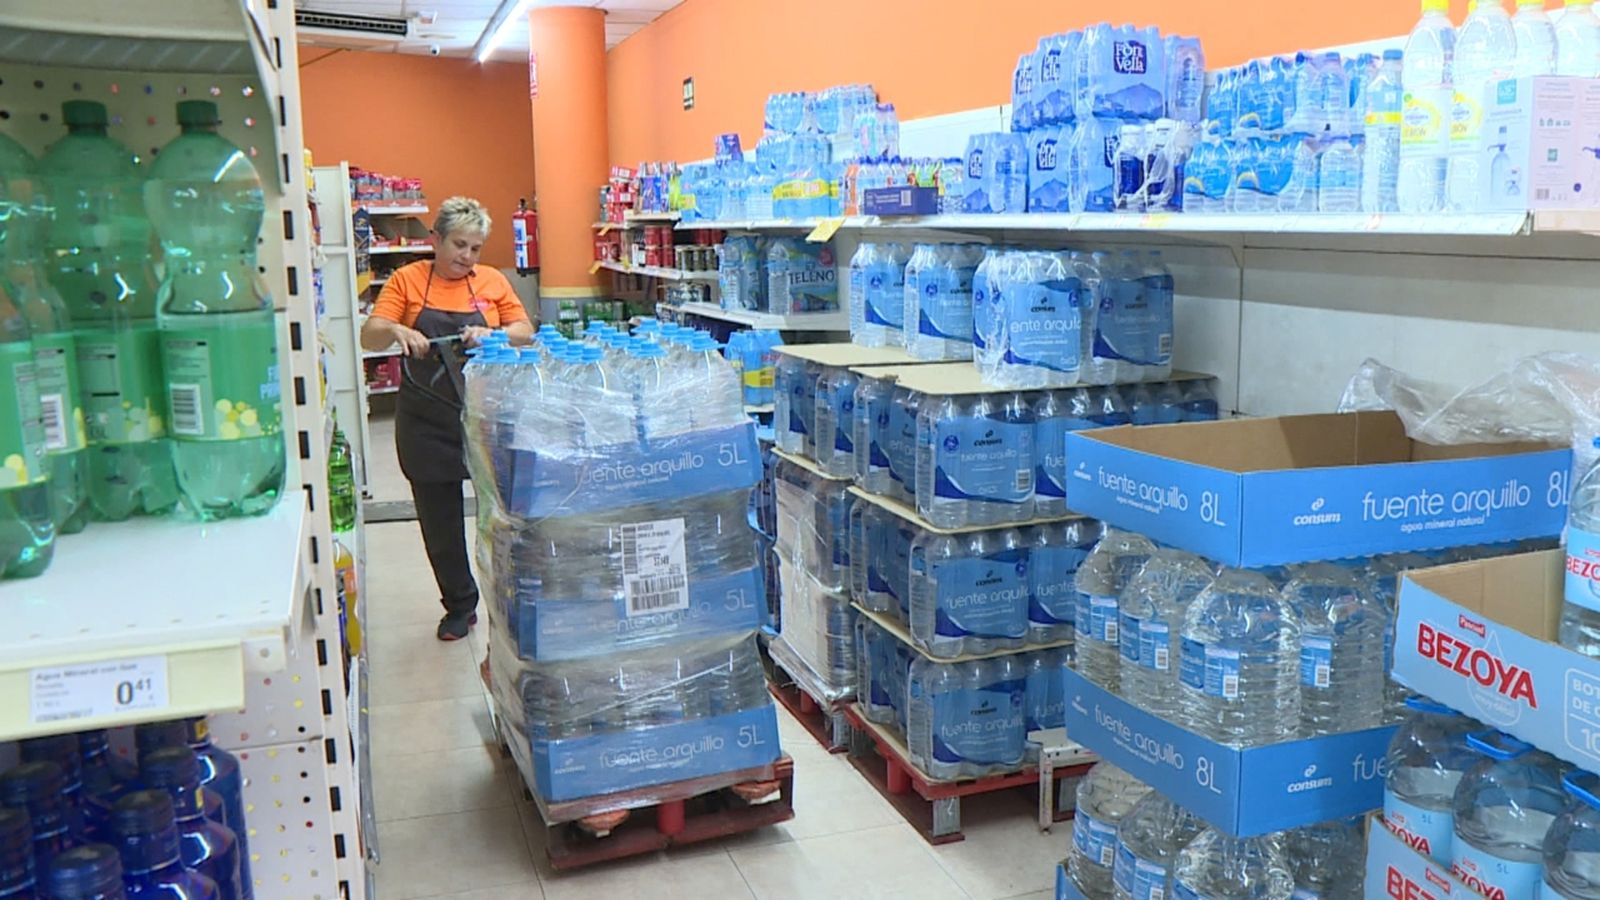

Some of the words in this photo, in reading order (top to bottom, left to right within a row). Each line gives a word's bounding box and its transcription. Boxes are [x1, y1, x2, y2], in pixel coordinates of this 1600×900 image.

[1115, 57, 1144, 73] Vella
[640, 451, 704, 477] arquillo
[718, 443, 747, 467] 5L
[1098, 465, 1136, 496] fuente
[1139, 482, 1188, 511] arquillo
[1200, 490, 1226, 527] 8L
[1362, 489, 1443, 522] fuente
[1451, 479, 1531, 516] arquillo
[1547, 470, 1570, 508] 8L
[1293, 512, 1341, 526] consum
[1424, 518, 1456, 532] mineral
[1456, 514, 1485, 527] natural
[724, 588, 754, 612] 5L
[1417, 622, 1538, 709] BEZOYA
[1573, 696, 1591, 714] DE
[600, 747, 658, 769] fuente
[663, 735, 724, 759] arquillo
[737, 725, 766, 748] 5L
[1095, 704, 1131, 742] fuente
[1134, 733, 1184, 770] arquillo
[1196, 756, 1222, 794] 8L
[1287, 777, 1332, 793] consum
